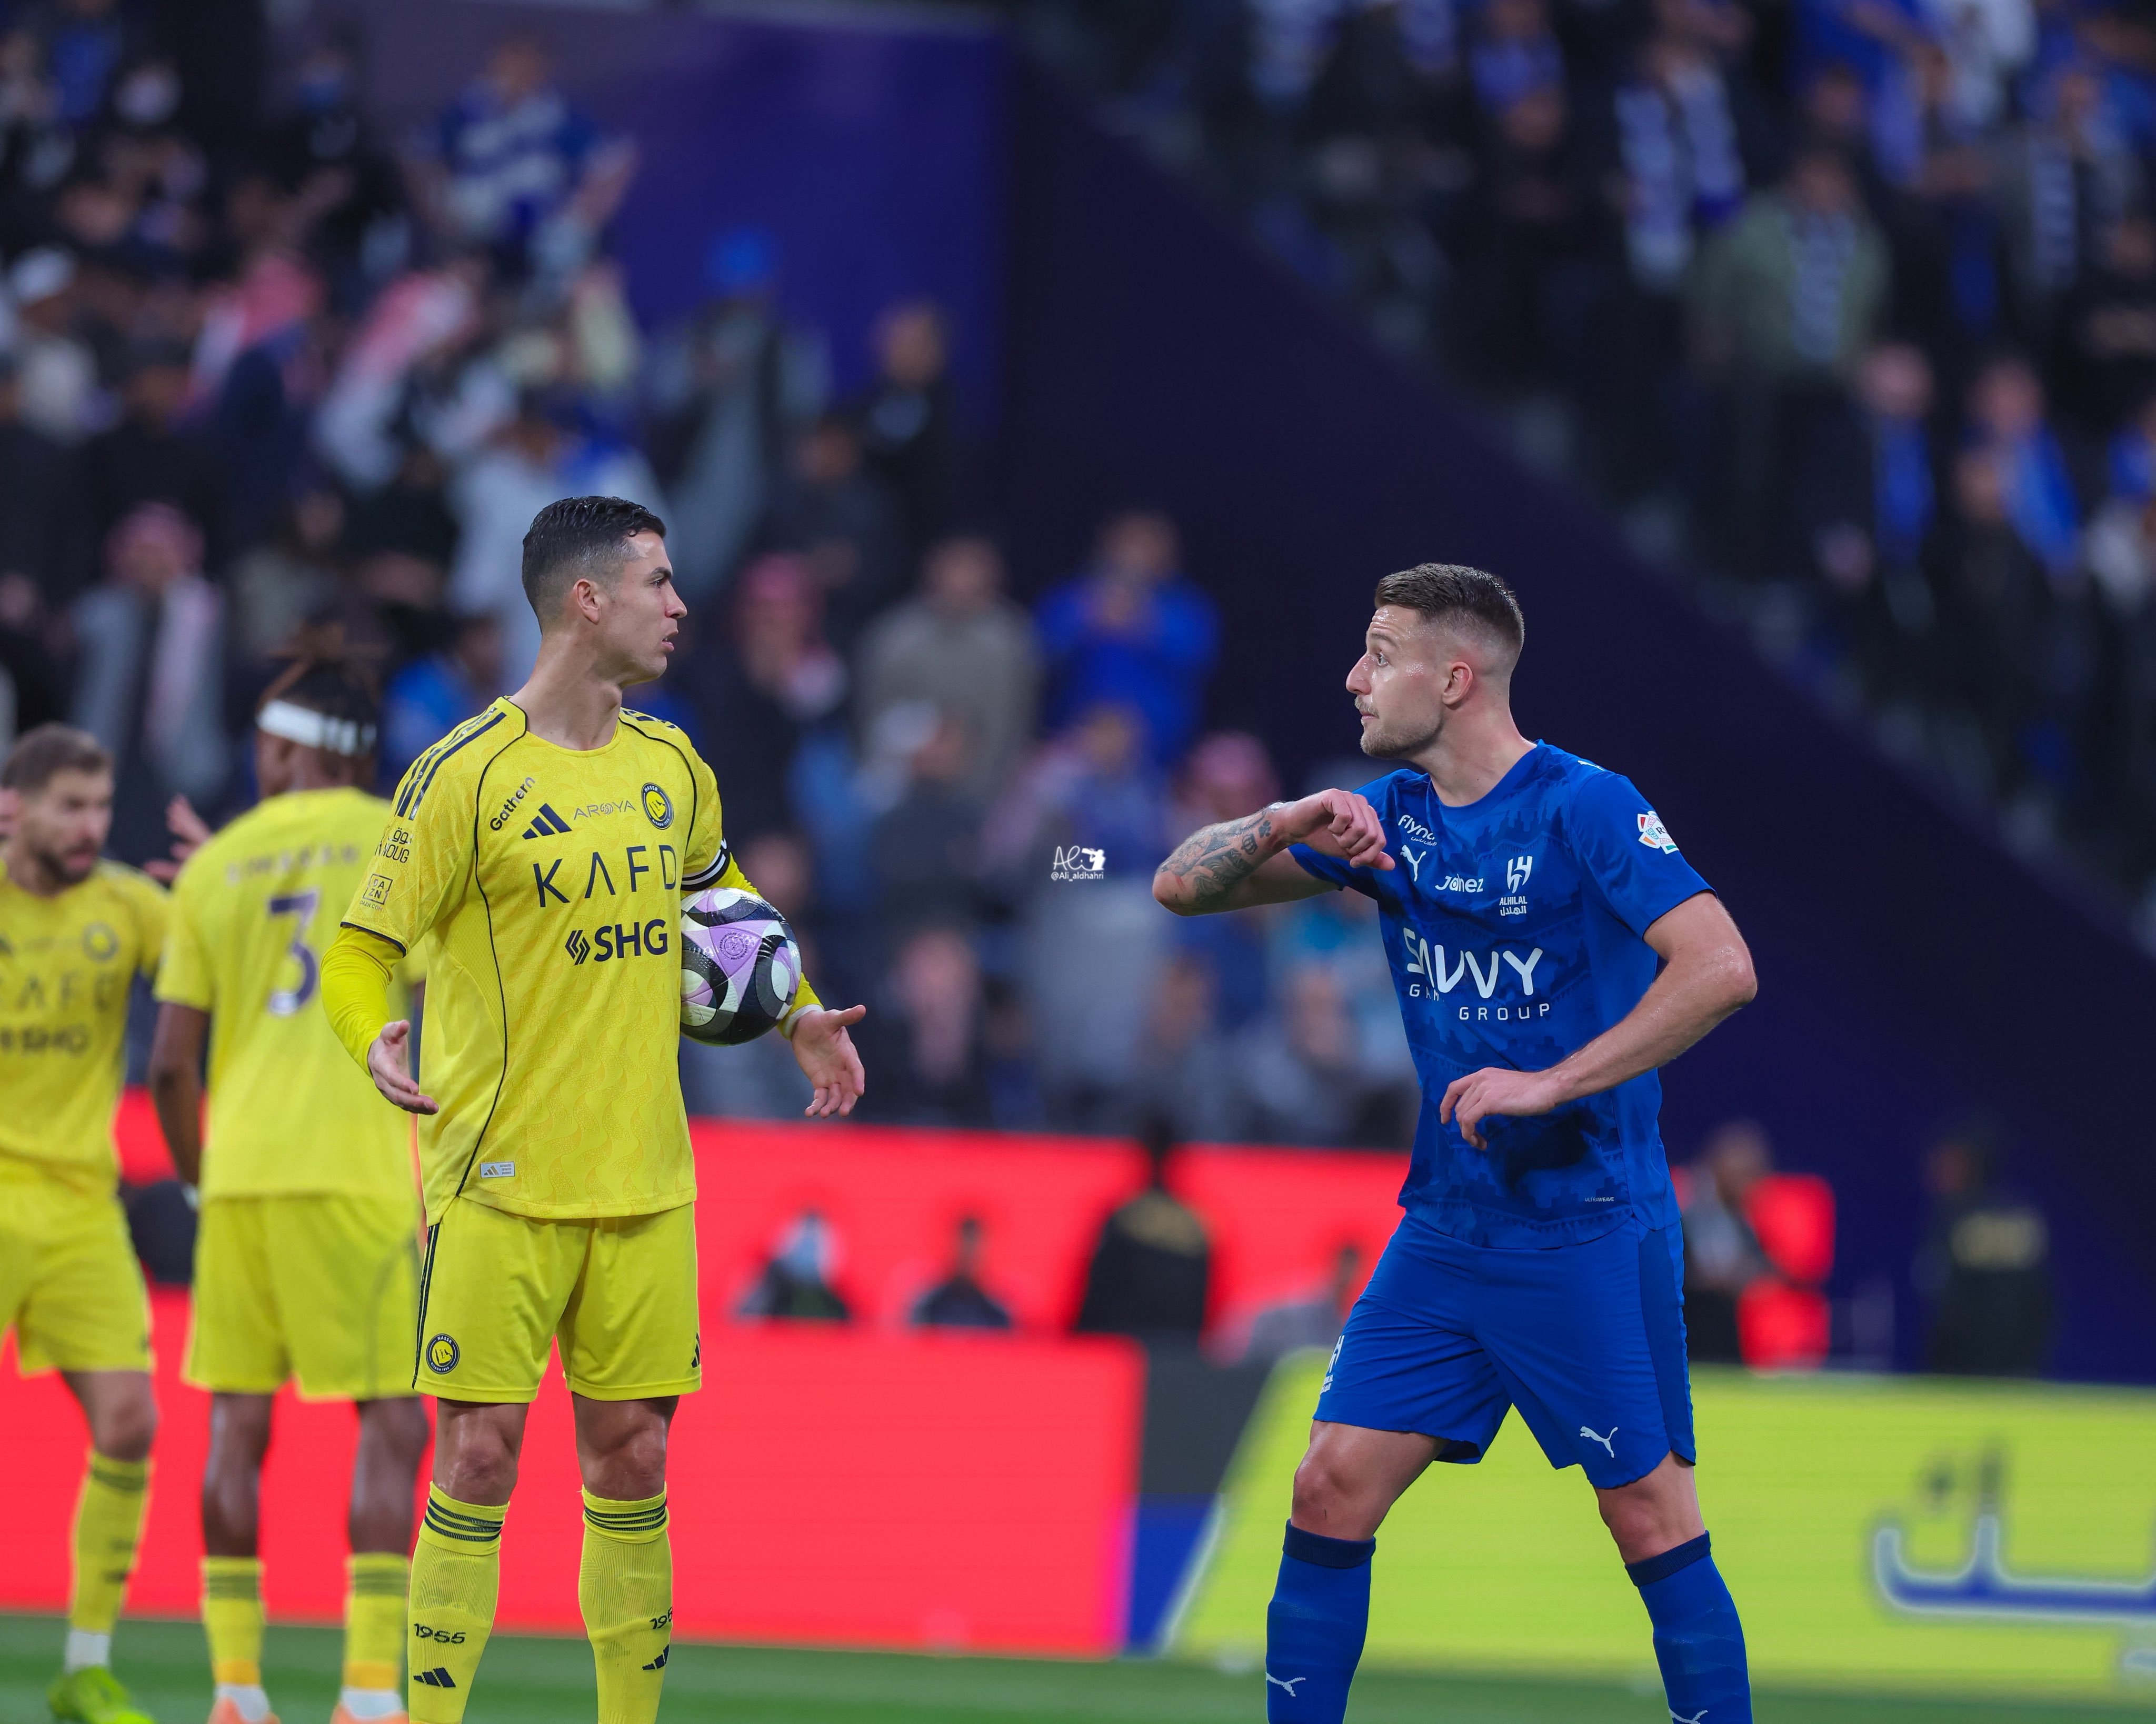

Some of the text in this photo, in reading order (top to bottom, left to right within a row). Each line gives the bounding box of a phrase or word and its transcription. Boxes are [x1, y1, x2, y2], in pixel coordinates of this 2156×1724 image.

[490, 777, 535, 831] Gathern
[533, 845, 676, 907] KAFD
[270, 888, 318, 1015] 3
[594, 919, 668, 962] SHG
[1459, 1003, 1550, 1020] GROUP
[437, 1336, 452, 1344] NASSR
[414, 1623, 466, 1643] 1955
